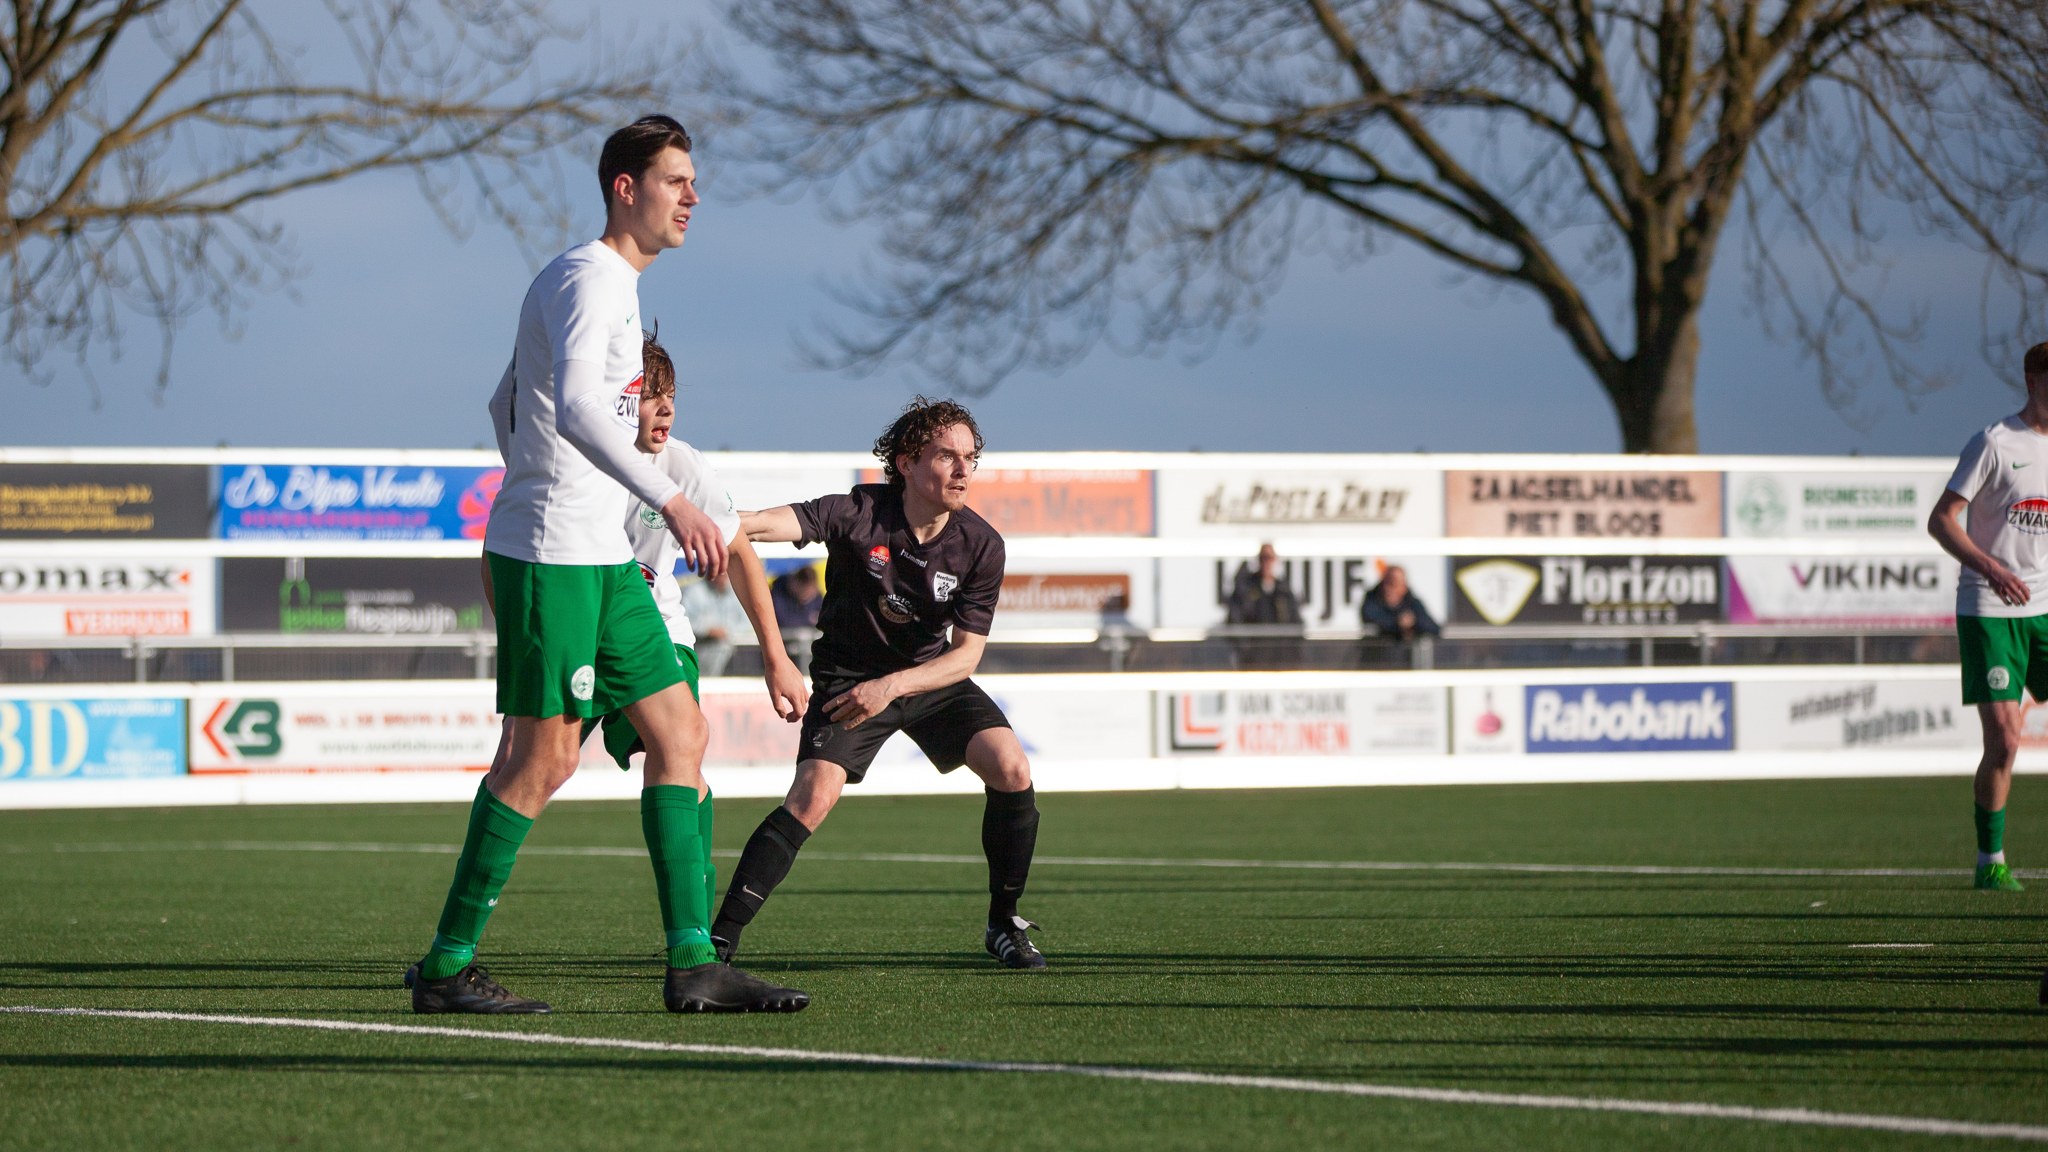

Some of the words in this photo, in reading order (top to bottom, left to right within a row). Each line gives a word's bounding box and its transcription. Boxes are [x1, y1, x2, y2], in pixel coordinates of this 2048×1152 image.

[617, 395, 639, 418] ZW
[1507, 510, 1559, 536] PIET
[1573, 511, 1663, 537] BLOOS
[870, 556, 886, 567] 2000
[871, 551, 889, 563] SPORT
[900, 548, 928, 568] hummel
[1541, 557, 1717, 604] Florizon
[1789, 561, 1939, 588] VIKING
[1530, 688, 1726, 742] Rabobank
